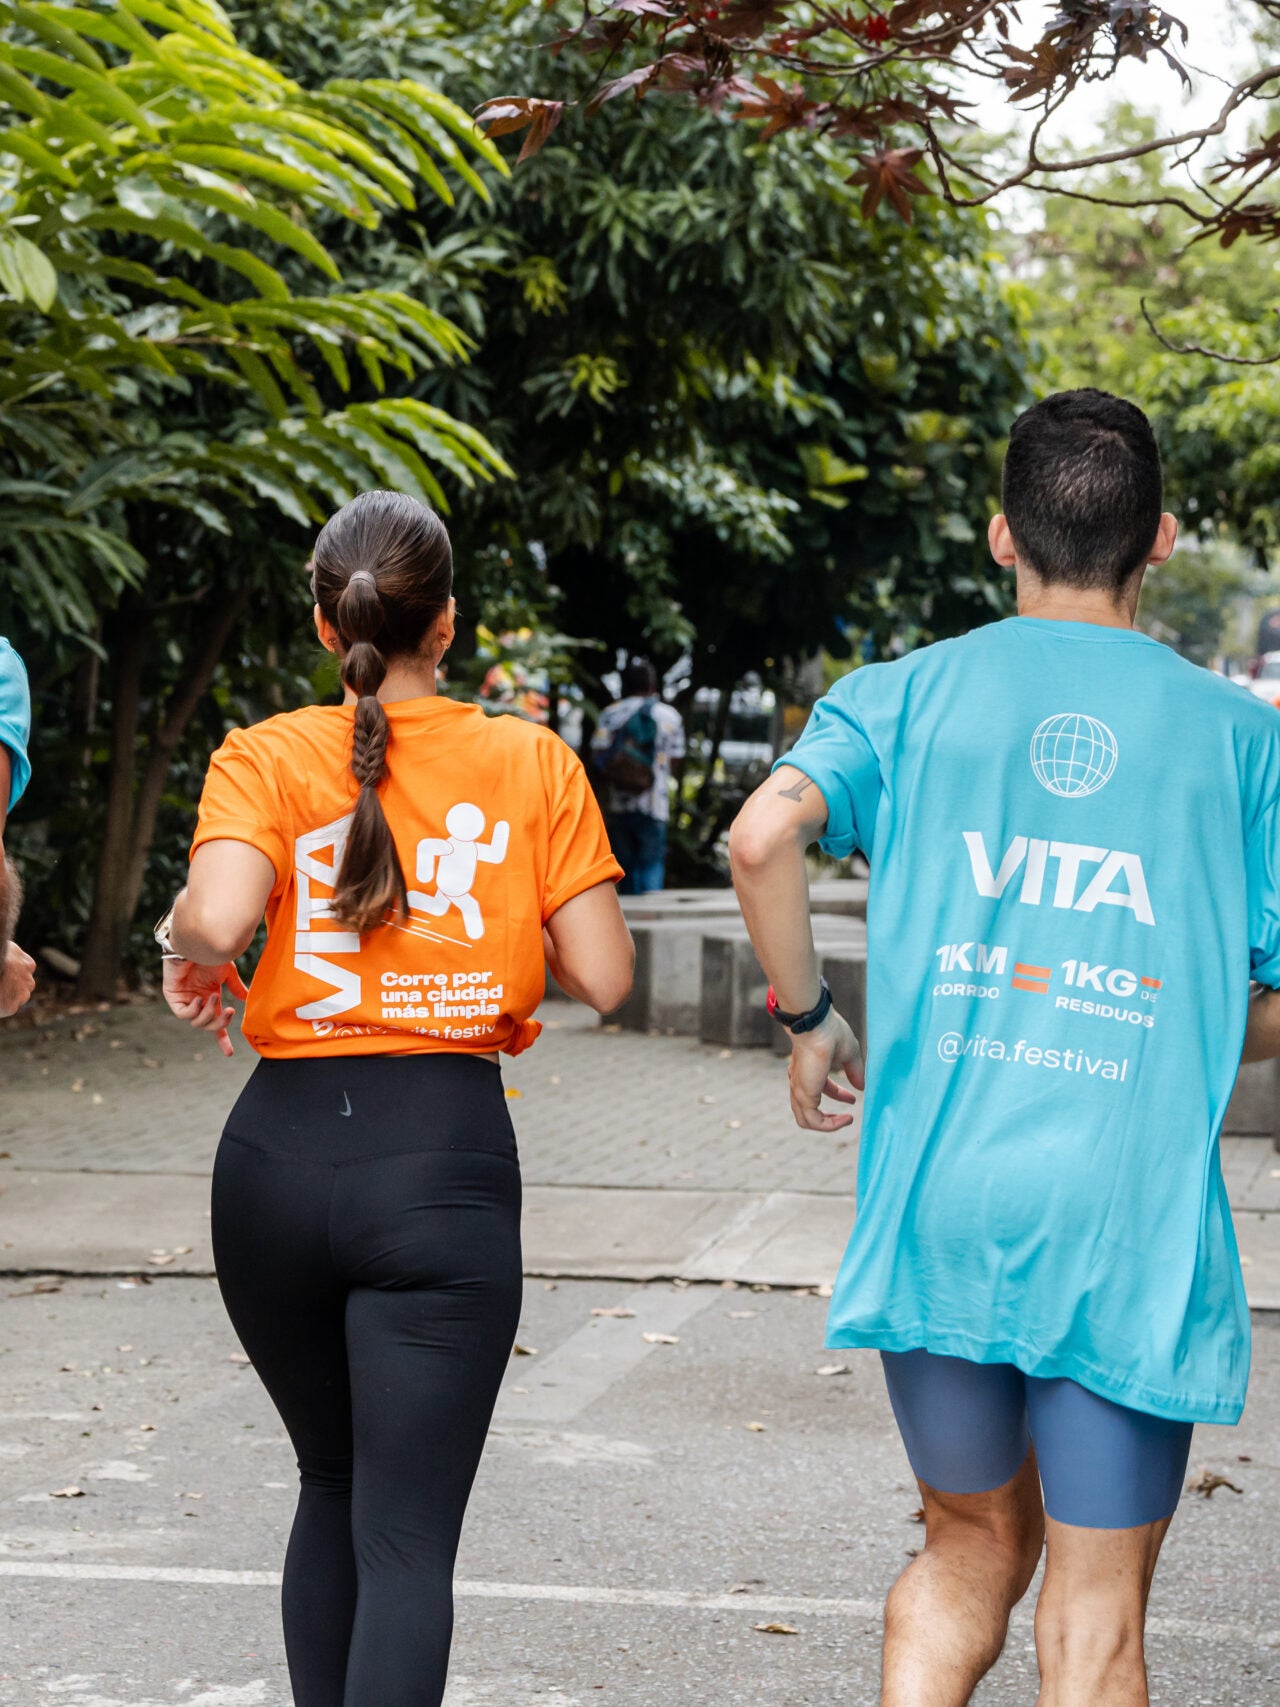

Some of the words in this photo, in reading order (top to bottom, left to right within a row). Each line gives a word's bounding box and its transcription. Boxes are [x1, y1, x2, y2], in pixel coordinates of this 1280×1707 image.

[962, 831, 1156, 926] VITA
[381, 971, 448, 987] Corre
[452, 971, 493, 987] por
[936, 942, 1008, 975] 1KM
[1060, 959, 1138, 997] 1KG
[380, 989, 422, 1003] una
[426, 984, 503, 1002] ciudad
[933, 983, 1000, 1000] CORRDO
[381, 1003, 430, 1019] más
[433, 1000, 500, 1019] limpia
[1055, 996, 1155, 1029] RESIDUOS
